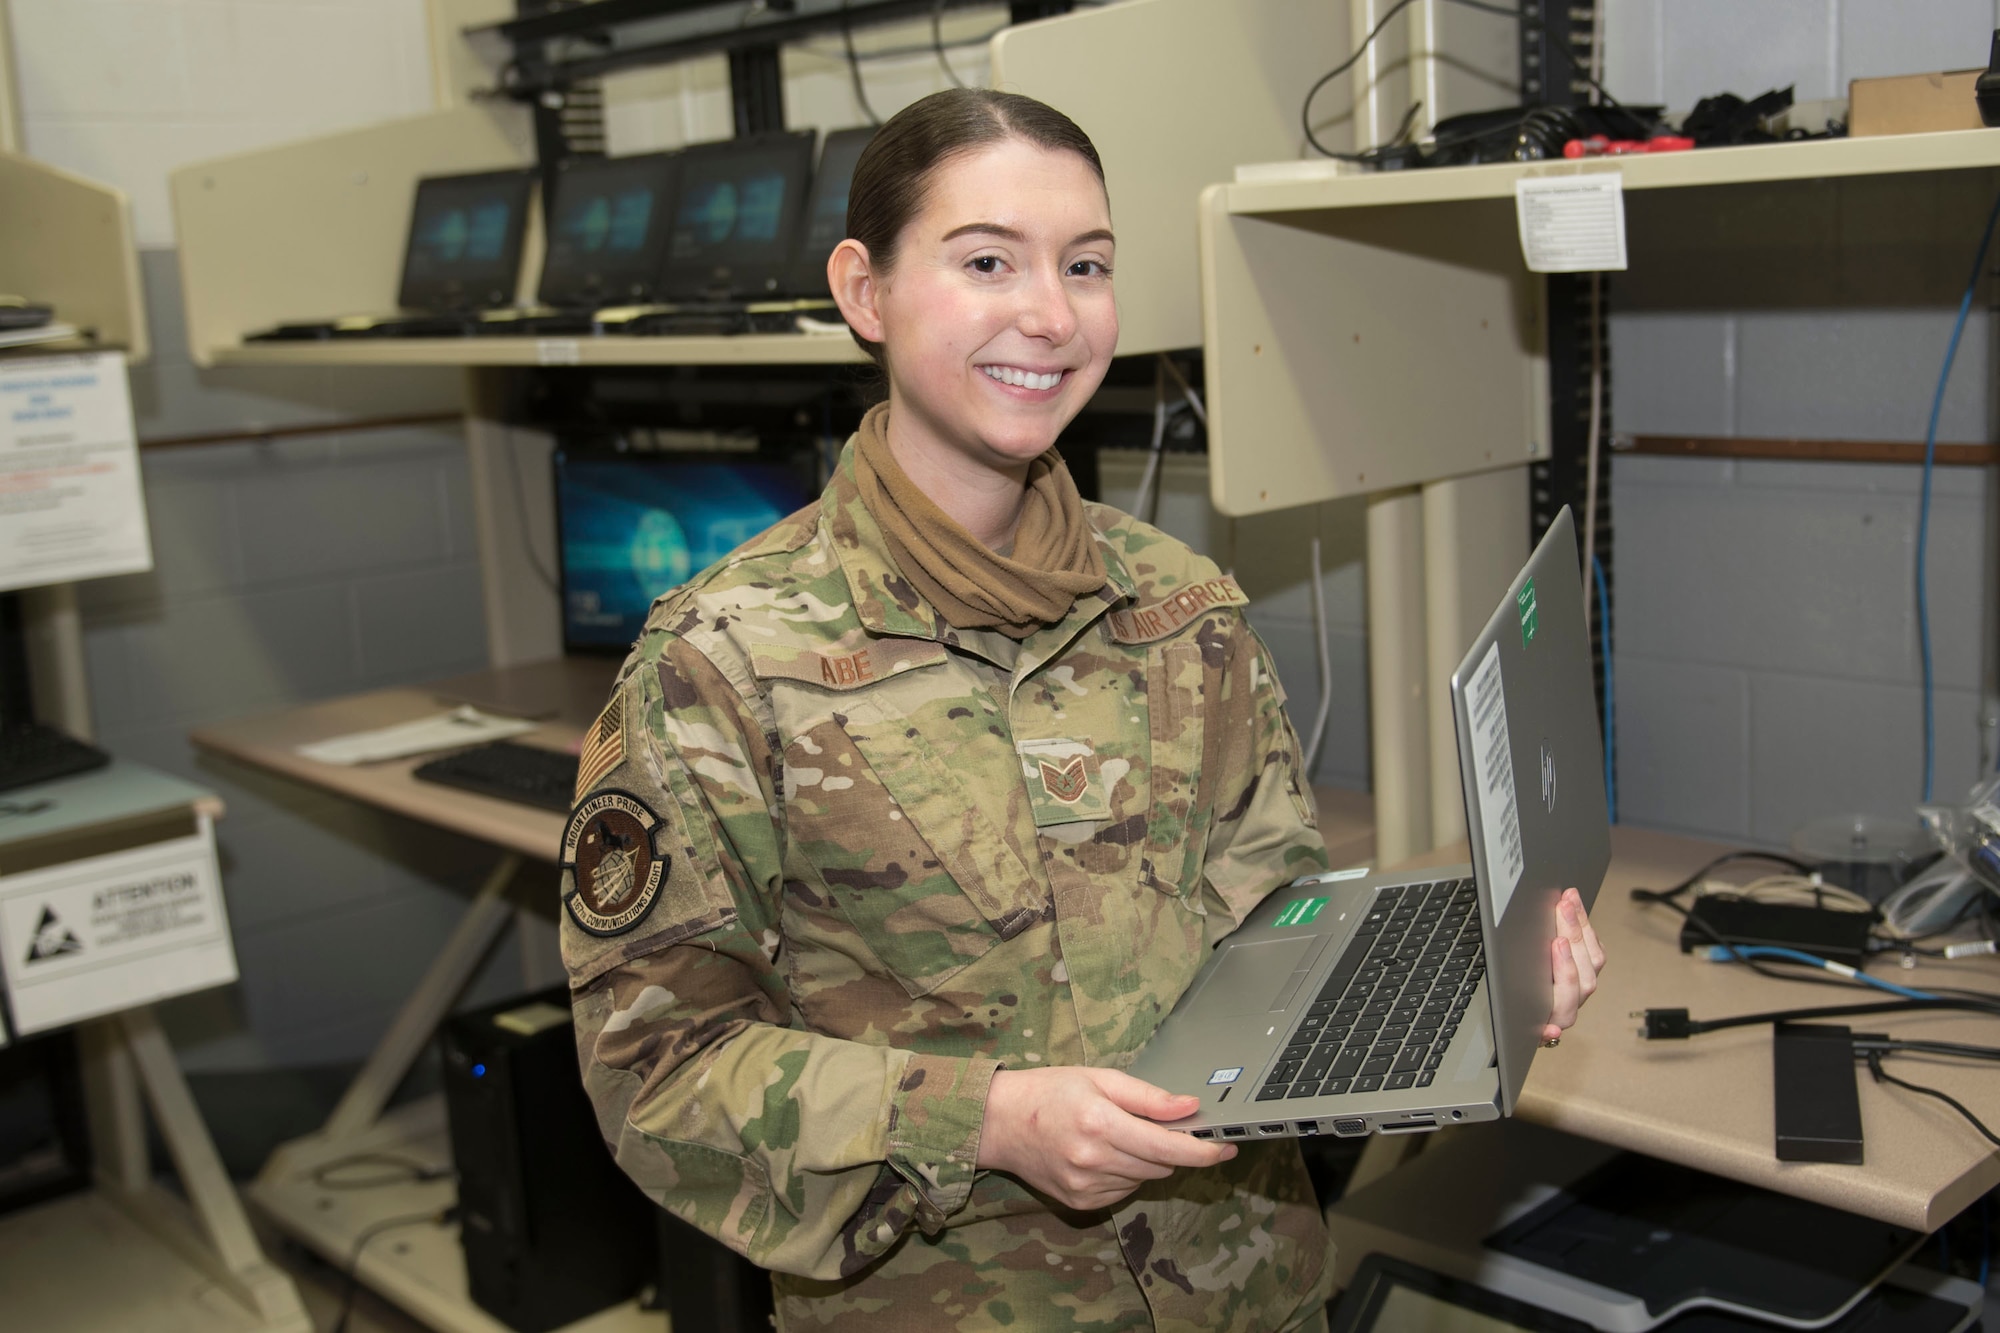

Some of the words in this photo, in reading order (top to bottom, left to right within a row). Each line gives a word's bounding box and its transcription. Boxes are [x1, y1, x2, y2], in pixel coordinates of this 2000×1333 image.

[1110, 613, 1130, 639] S
[1131, 610, 1169, 638] AIR
[1163, 579, 1240, 626] FORCE
[821, 649, 873, 684] ABE
[567, 796, 614, 849] MOUNTAINEER
[616, 797, 645, 819] PRIDE
[586, 897, 648, 929] COMMUNICATIONS
[645, 863, 661, 897] FLIGHT
